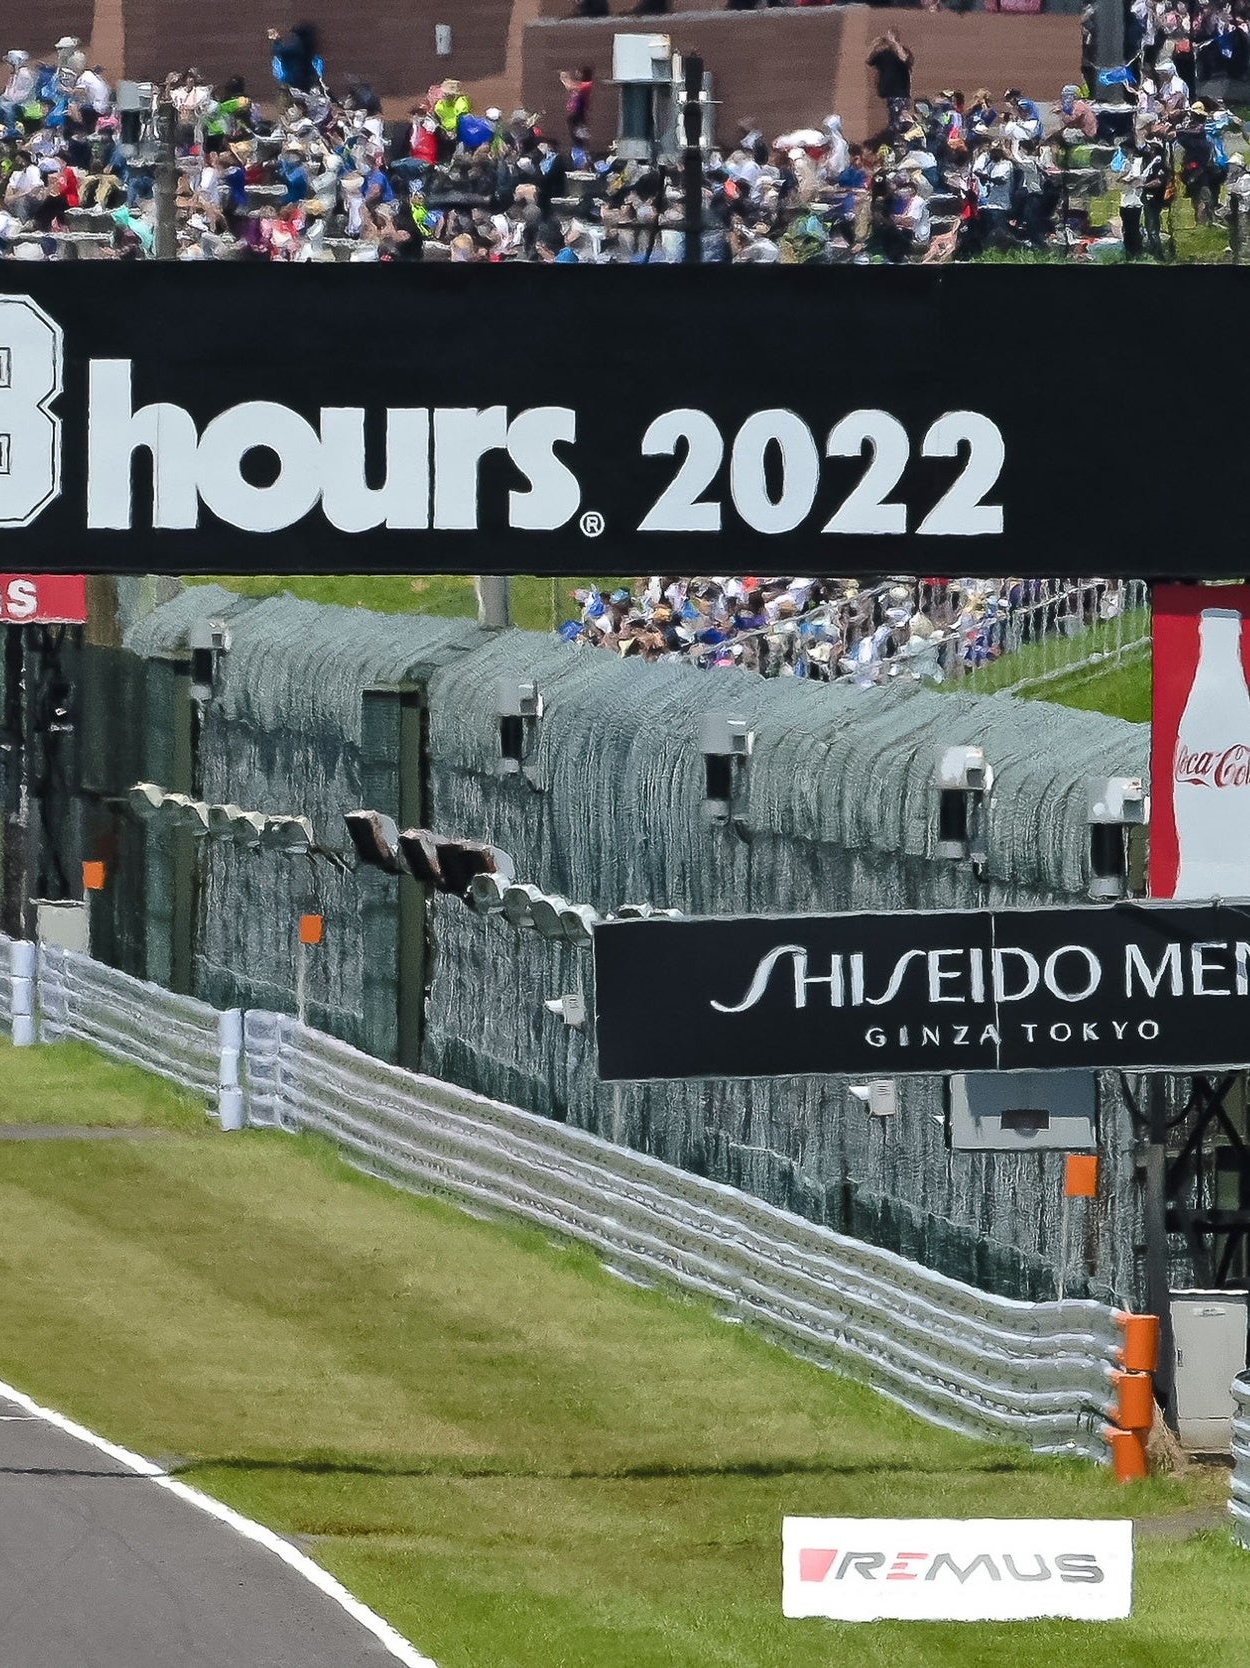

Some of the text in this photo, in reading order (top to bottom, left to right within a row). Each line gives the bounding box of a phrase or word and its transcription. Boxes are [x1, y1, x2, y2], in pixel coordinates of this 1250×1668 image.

[636, 408, 1006, 536] 2022
[710, 942, 1250, 1013] SHISEIDO ME
[864, 1019, 1160, 1048] GINZA TOKYO
[834, 1552, 1105, 1584] REMUS
